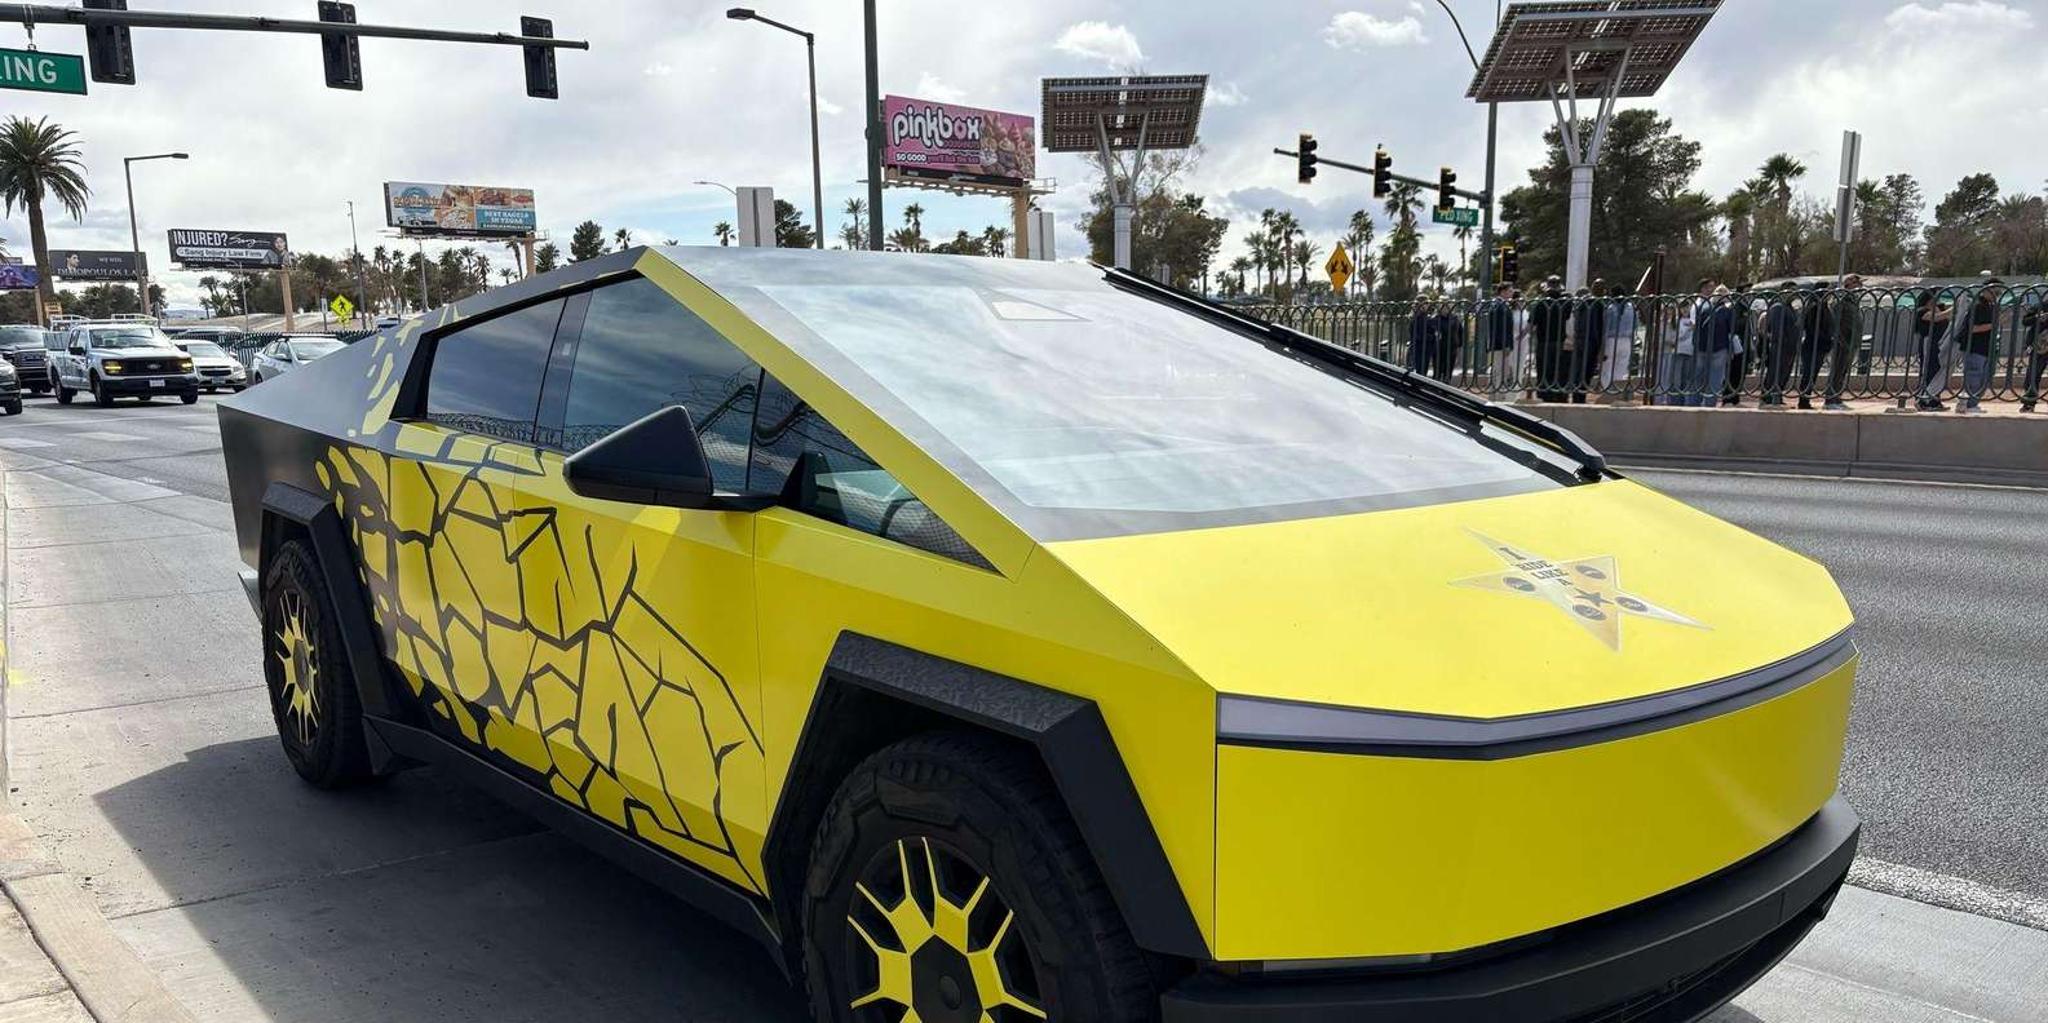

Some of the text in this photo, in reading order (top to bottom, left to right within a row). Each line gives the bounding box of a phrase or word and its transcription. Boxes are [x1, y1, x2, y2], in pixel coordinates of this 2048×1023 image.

[0, 55, 57, 84] ING
[893, 106, 982, 147] pinkbox
[896, 153, 907, 162] SO
[907, 153, 927, 162] GOOD
[173, 231, 228, 246] INJURED?
[245, 250, 262, 258] Firm
[1515, 560, 1554, 572] RIDE
[1530, 568, 1569, 580] LIKE
